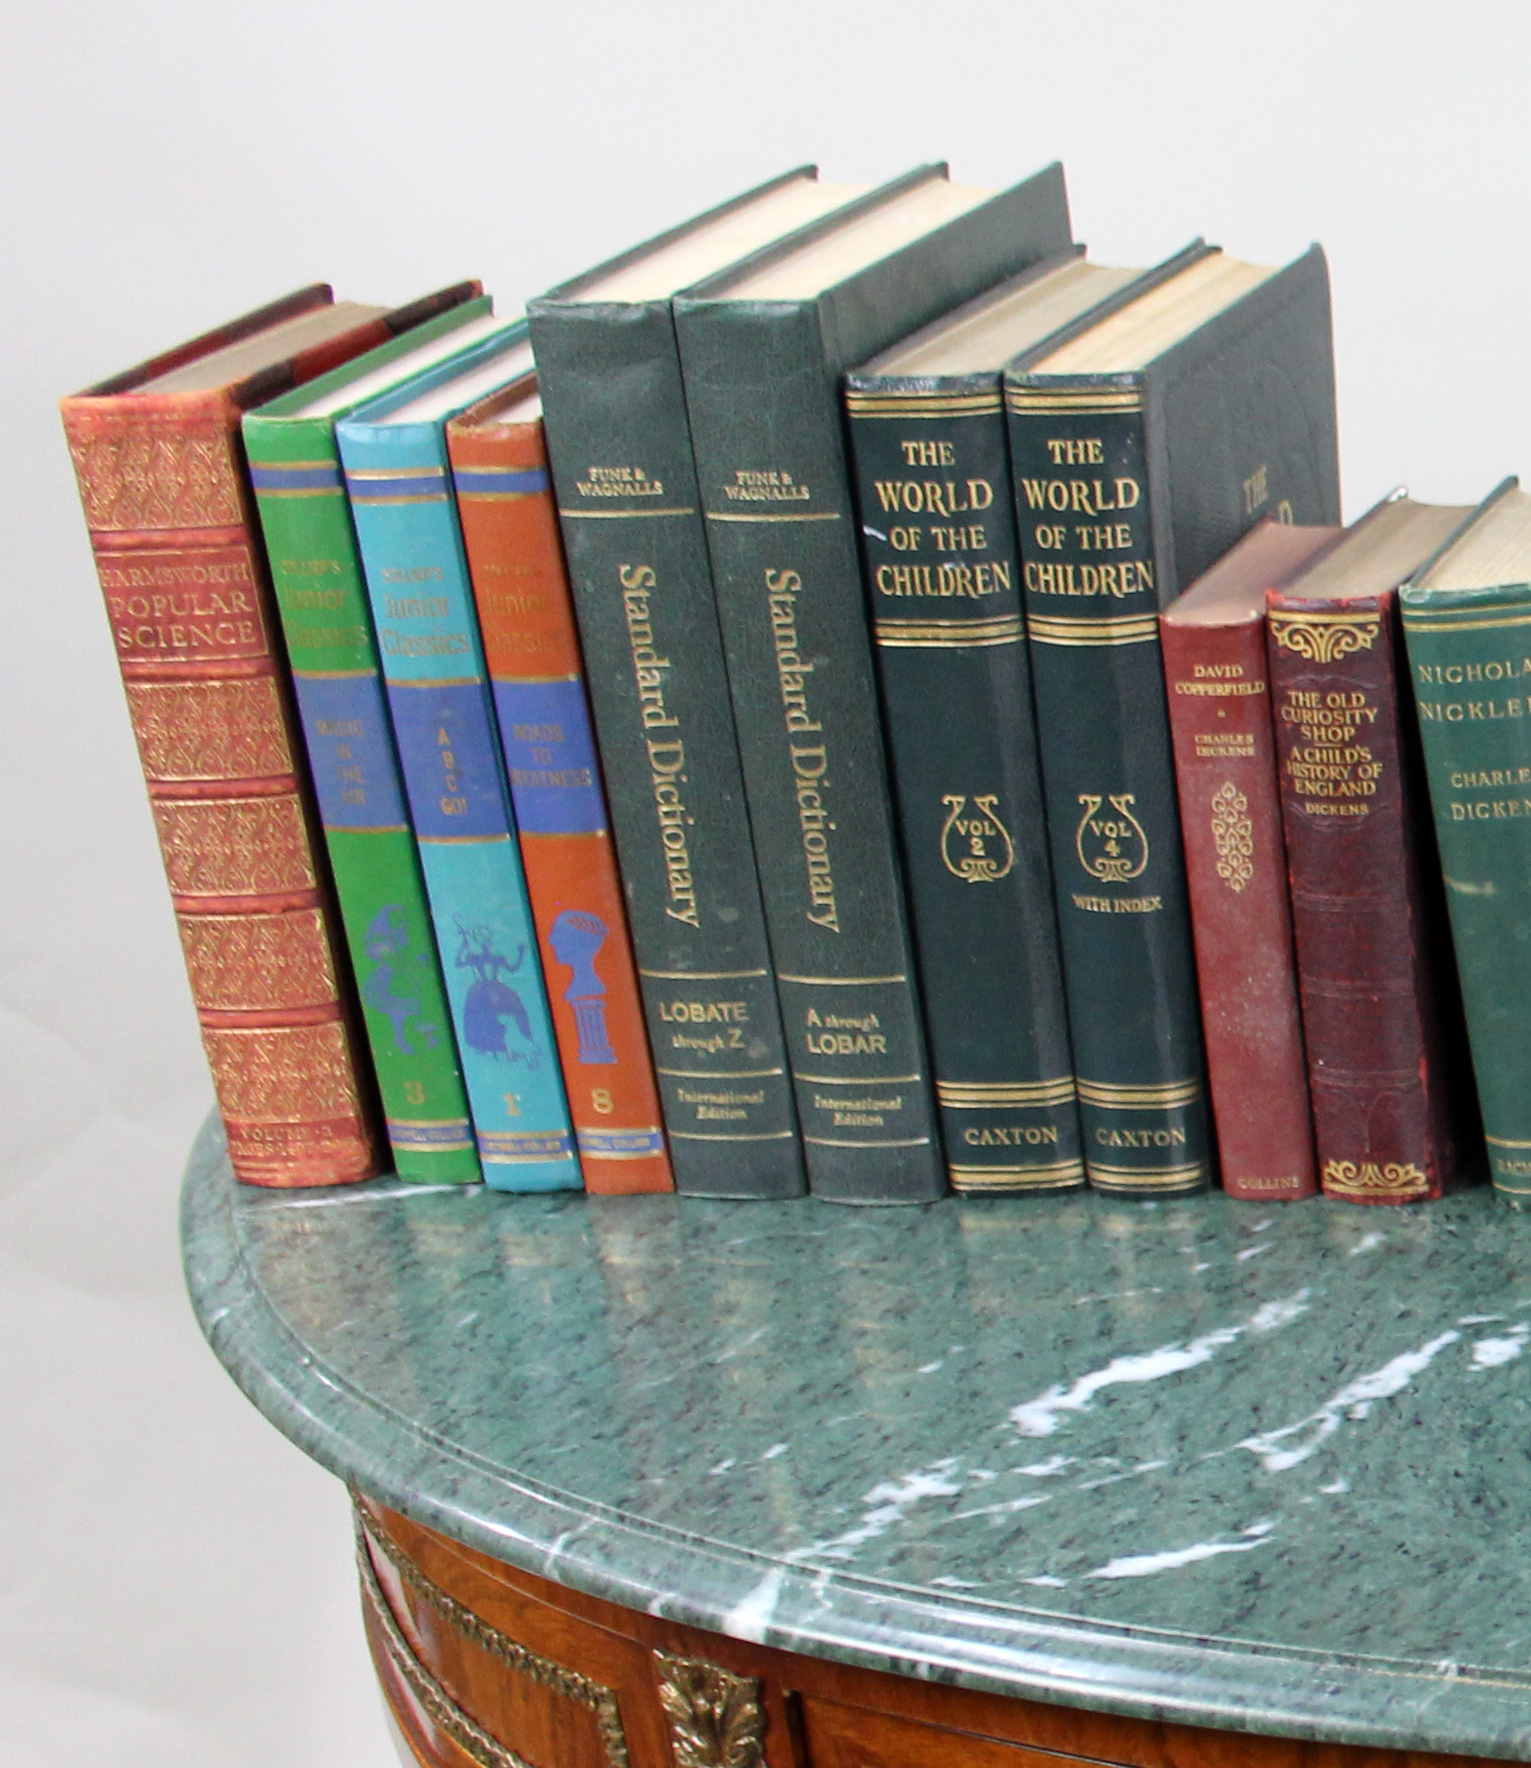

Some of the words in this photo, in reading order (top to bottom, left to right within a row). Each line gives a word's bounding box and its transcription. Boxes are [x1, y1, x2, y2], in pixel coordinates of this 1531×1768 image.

[902, 441, 955, 466] THE
[1047, 438, 1104, 465] THE
[588, 466, 633, 482] FUNK
[635, 468, 646, 481] &
[735, 470, 778, 486] FUNK
[781, 471, 792, 485] &
[577, 480, 663, 497] WAGNALLS
[724, 485, 810, 500] WAGNALLS
[875, 478, 994, 517] WORLD
[1022, 477, 1140, 516] WORLD
[891, 527, 921, 551] OF
[931, 525, 987, 551] THE
[1035, 525, 1067, 550] OF
[1075, 523, 1132, 549] THE
[98, 563, 250, 587] HARMSWORTH
[876, 561, 1012, 598] CHILDREN
[1024, 559, 1155, 598] CHILDREN
[110, 591, 253, 618] POPULAR
[119, 620, 257, 648] SCIENCE
[380, 627, 471, 657] Classics
[619, 564, 680, 730] Standard
[765, 568, 823, 733] Standard
[1194, 664, 1244, 678] DAVID
[1175, 681, 1265, 696] COPPERFIELD
[1288, 691, 1321, 707] THE
[1326, 691, 1366, 708] OLD
[1281, 707, 1378, 726] CURIOSITY
[1194, 733, 1254, 745] CHARLES
[1301, 726, 1355, 742] SHOP
[1196, 746, 1255, 757] DICKENS
[1291, 746, 1304, 762] A
[1305, 745, 1373, 764] CHILD'S
[1286, 760, 1350, 779] HISTORY
[1358, 763, 1383, 778] OF
[1296, 780, 1376, 797] ENGLAND
[1306, 803, 1369, 816] DICKENS
[647, 738, 700, 928] Dictionary
[790, 743, 840, 933] Dictionary
[955, 819, 996, 837] VOL
[1090, 819, 1132, 838] VOL
[970, 838, 985, 857] 2
[1104, 840, 1121, 858] 4
[1071, 894, 1110, 912] WITH
[1113, 895, 1163, 913] INDEX
[659, 1002, 749, 1023] LOBATE
[806, 1008, 820, 1027] A
[824, 1013, 880, 1032] through
[672, 1034, 724, 1053] through
[727, 1027, 745, 1048] Z
[806, 1033, 887, 1054] LOBAR
[403, 1081, 425, 1104] 3
[591, 1087, 614, 1114] 8
[677, 1088, 764, 1104] International
[503, 1092, 522, 1116] 1
[696, 1106, 747, 1120] Edition
[814, 1095, 902, 1111] International
[833, 1112, 884, 1126] Edition
[964, 1126, 1058, 1147] CAXTON
[1096, 1127, 1187, 1147] CAXTON
